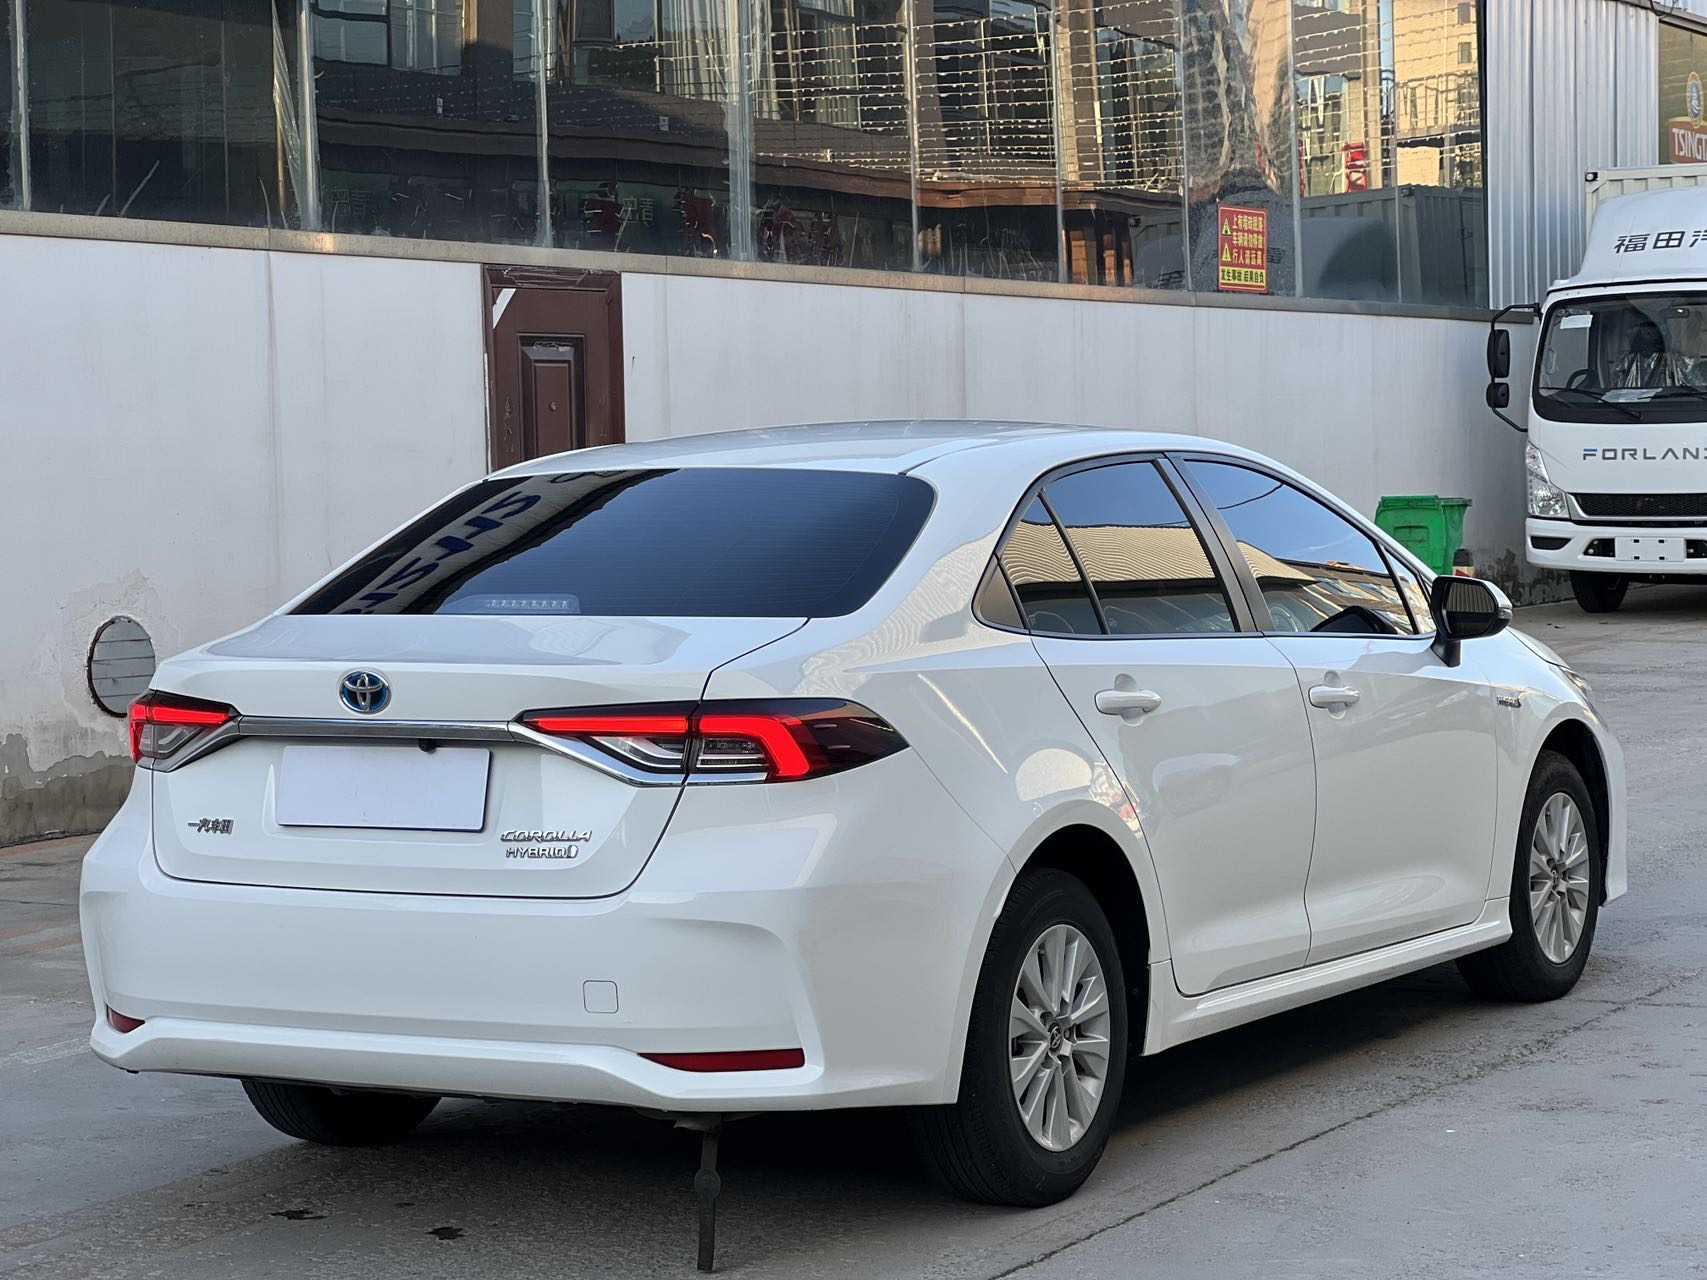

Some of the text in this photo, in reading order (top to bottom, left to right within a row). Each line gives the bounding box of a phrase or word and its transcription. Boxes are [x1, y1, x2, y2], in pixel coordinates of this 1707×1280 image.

[1582, 448, 1707, 461] FORLAN
[500, 830, 592, 843] COROLLA
[506, 845, 568, 859] HYBRID
